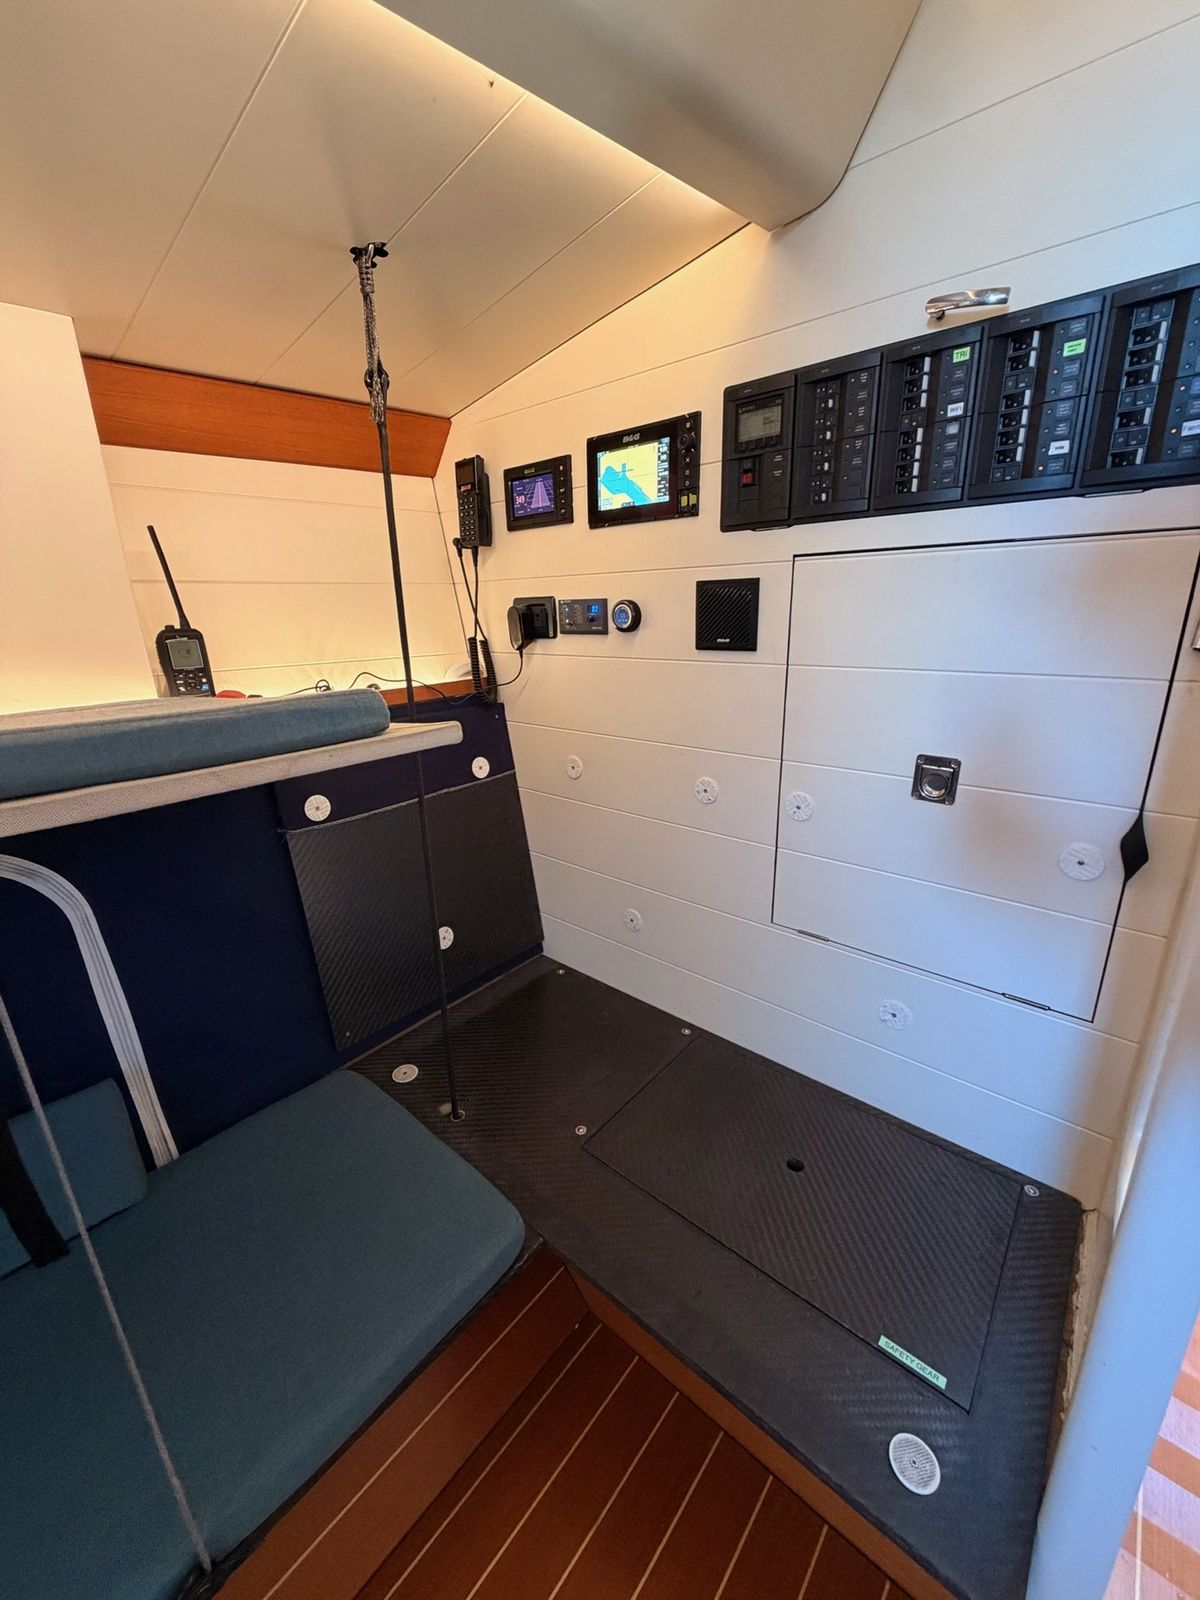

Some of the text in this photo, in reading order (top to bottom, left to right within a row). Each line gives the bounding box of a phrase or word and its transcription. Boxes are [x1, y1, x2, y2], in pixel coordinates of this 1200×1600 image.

[955, 350, 968, 360] TRI
[884, 1341, 940, 1382] SAFETY GEAR
